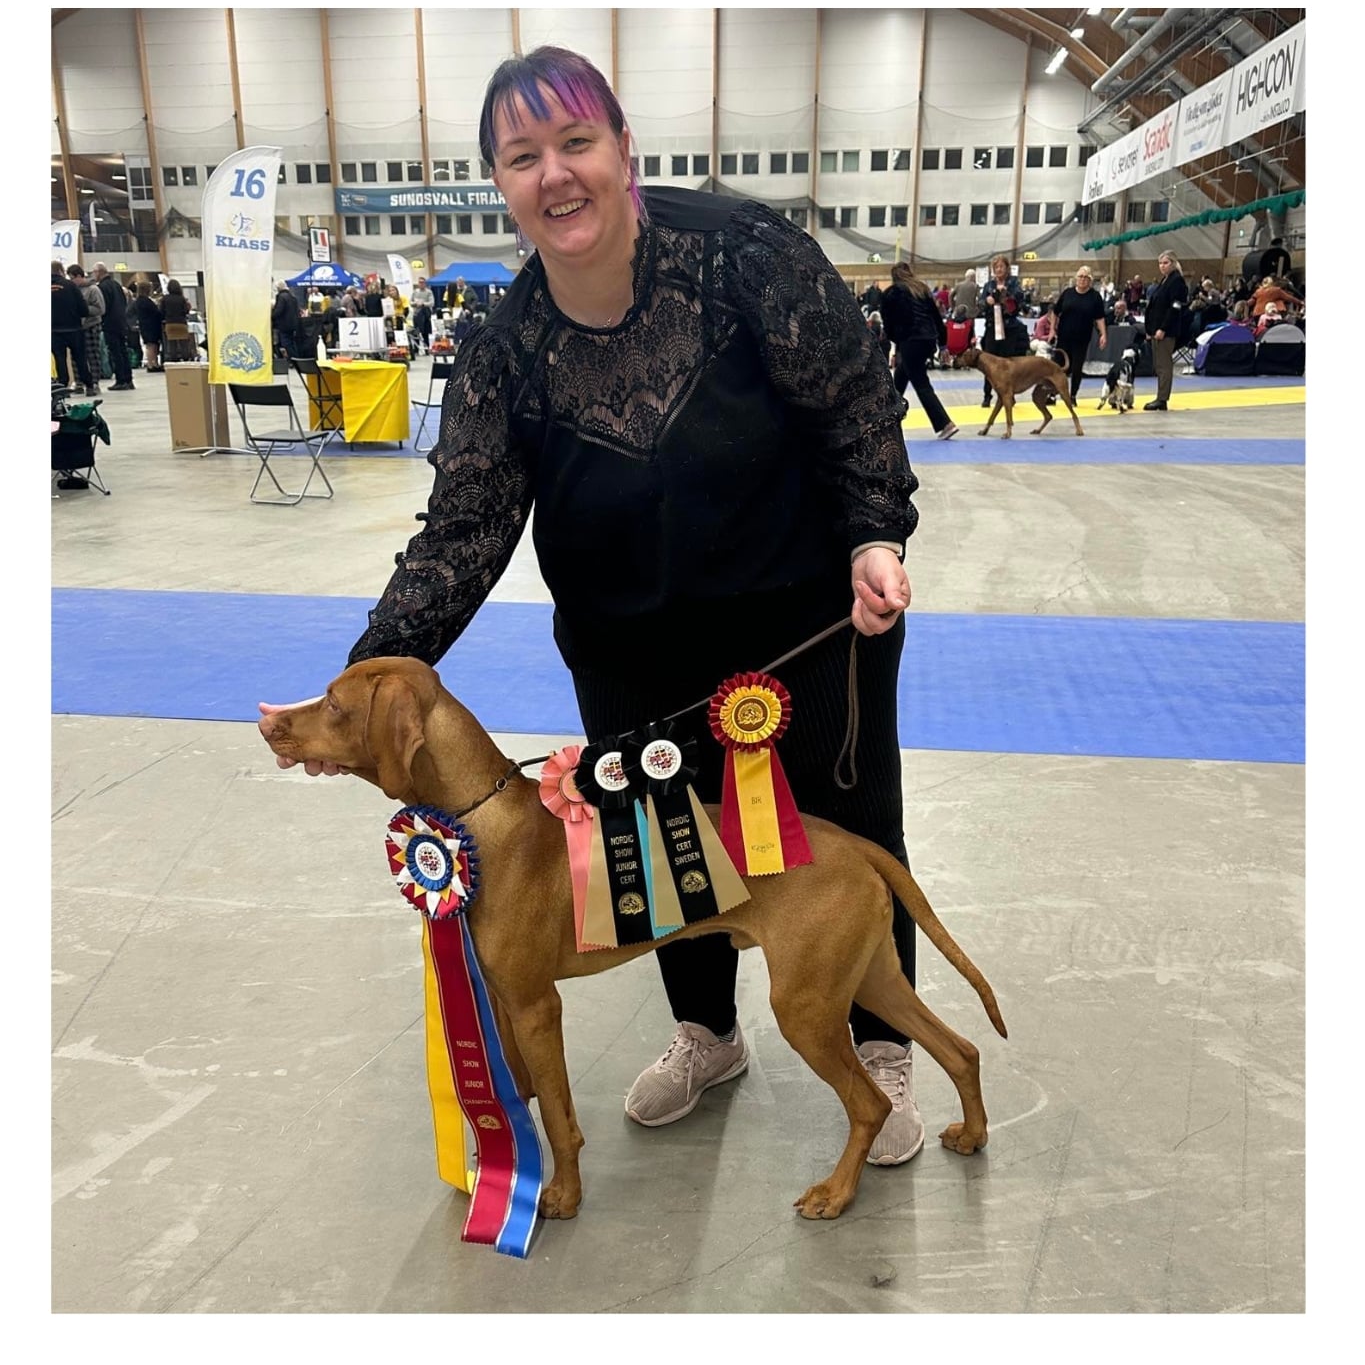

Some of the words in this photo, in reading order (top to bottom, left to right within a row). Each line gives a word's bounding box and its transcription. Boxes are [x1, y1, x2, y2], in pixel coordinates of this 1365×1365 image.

[1236, 39, 1298, 115] HIGHCON
[230, 169, 266, 200] 16
[52, 231, 73, 249] 10
[215, 235, 271, 251] KLASS
[348, 320, 359, 336] 2
[666, 814, 690, 828] NORDIC
[610, 834, 634, 846] NORDIC
[671, 827, 690, 840] SHOW
[676, 840, 692, 852] CERT
[614, 848, 633, 858] SHOW
[674, 851, 700, 866] SWEDEN
[615, 860, 638, 872] JUNIOR
[620, 874, 636, 885] CERT
[462, 1059, 480, 1068] SHOW
[464, 1080, 484, 1089] JUNIOR
